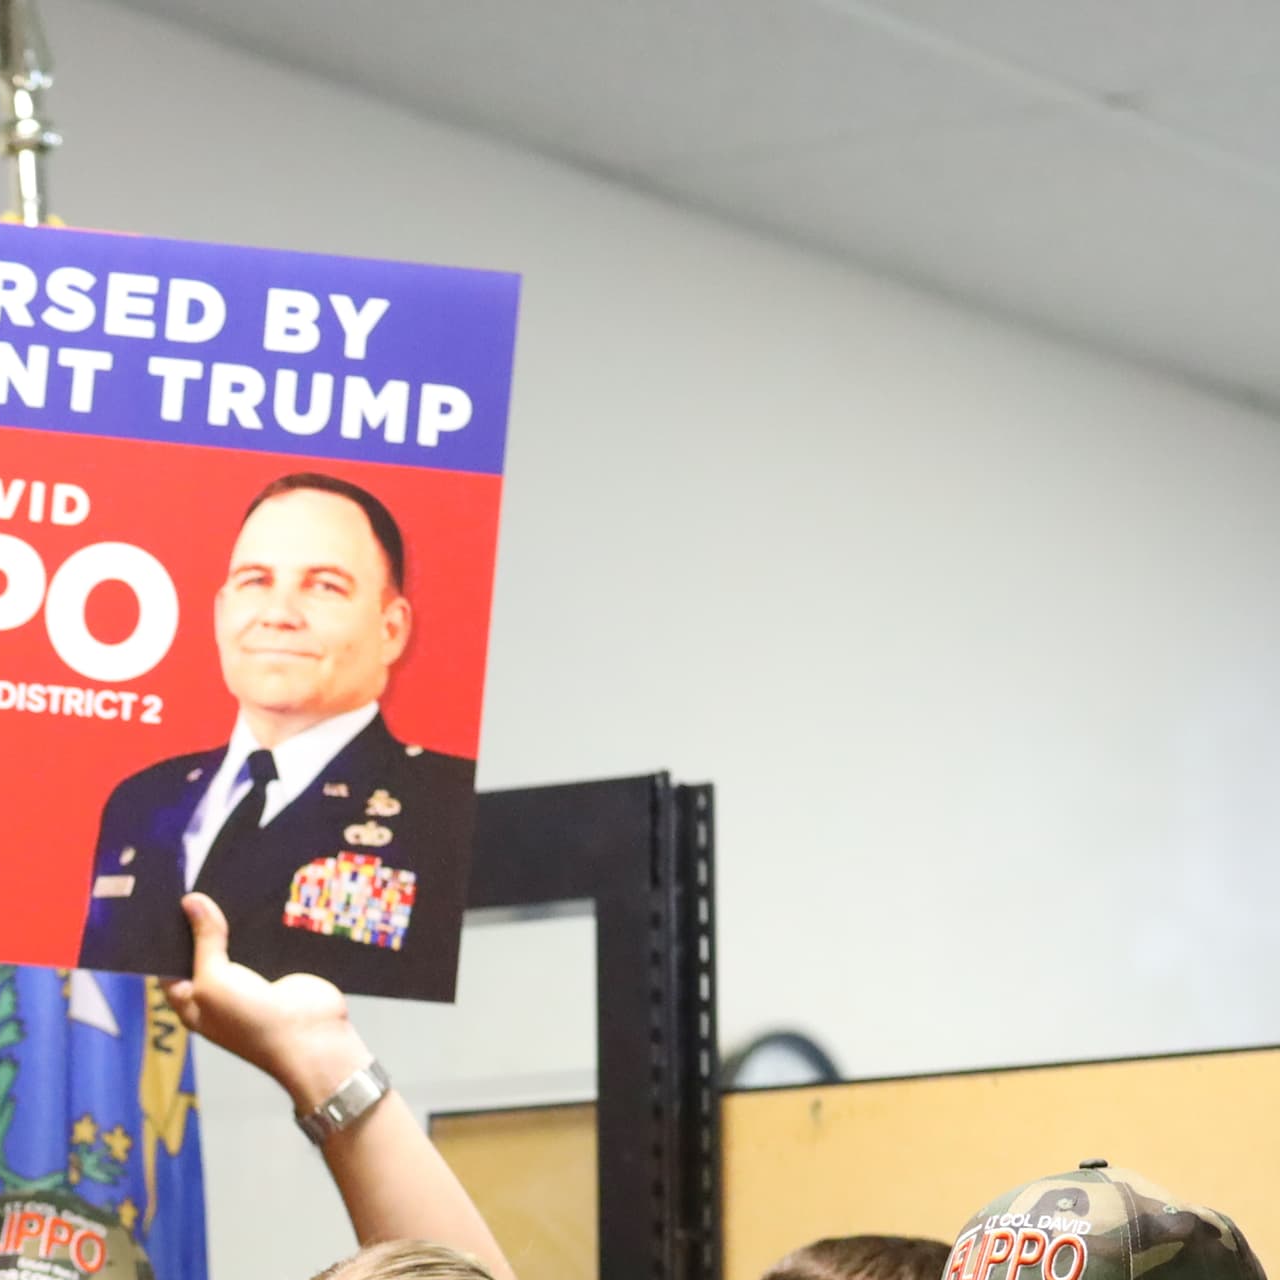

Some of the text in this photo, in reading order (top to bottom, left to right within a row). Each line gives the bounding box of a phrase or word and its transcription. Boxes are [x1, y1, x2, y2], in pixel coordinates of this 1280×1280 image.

[261, 286, 392, 361] BY
[146, 354, 474, 448] TRUMP
[139, 693, 164, 722] 2
[984, 1212, 1093, 1236] LT COL DAVID
